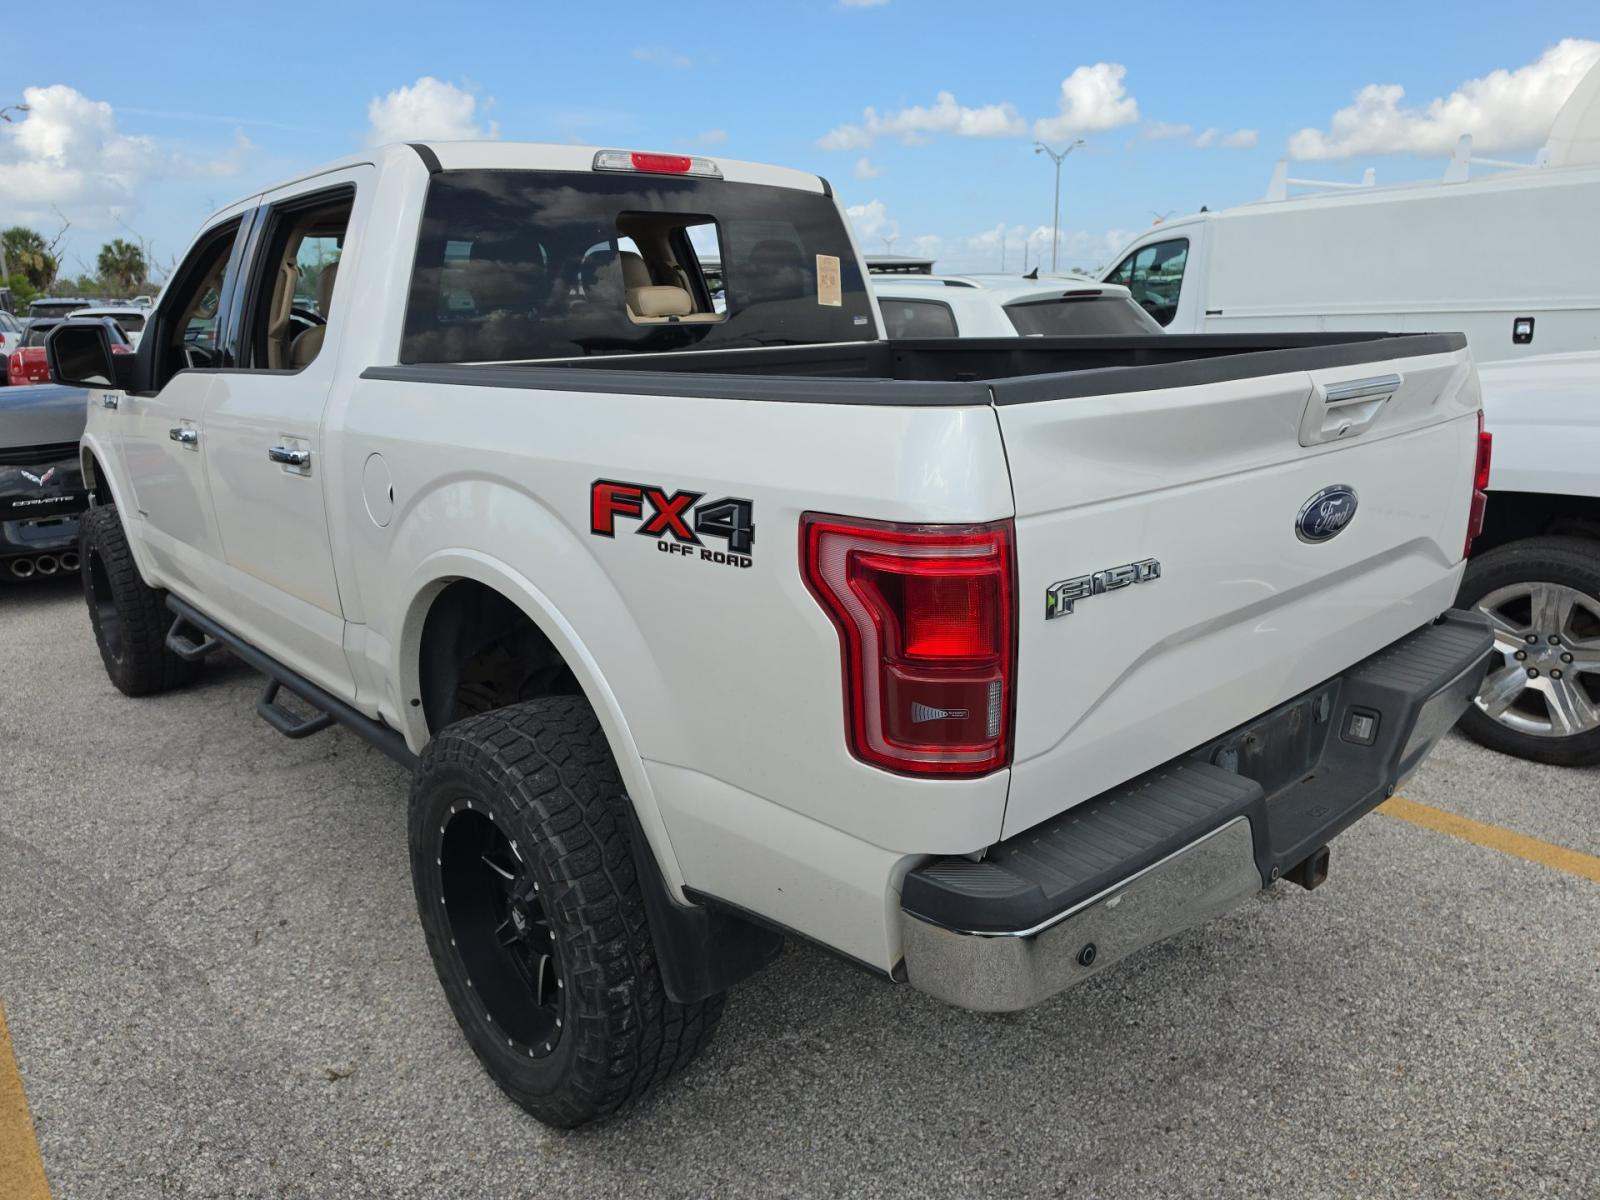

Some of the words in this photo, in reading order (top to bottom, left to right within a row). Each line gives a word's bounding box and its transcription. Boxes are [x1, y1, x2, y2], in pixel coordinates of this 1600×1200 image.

[590, 478, 755, 556] FX4
[1314, 499, 1350, 533] Ford
[657, 540, 694, 556] OFF
[700, 548, 753, 569] ROAD
